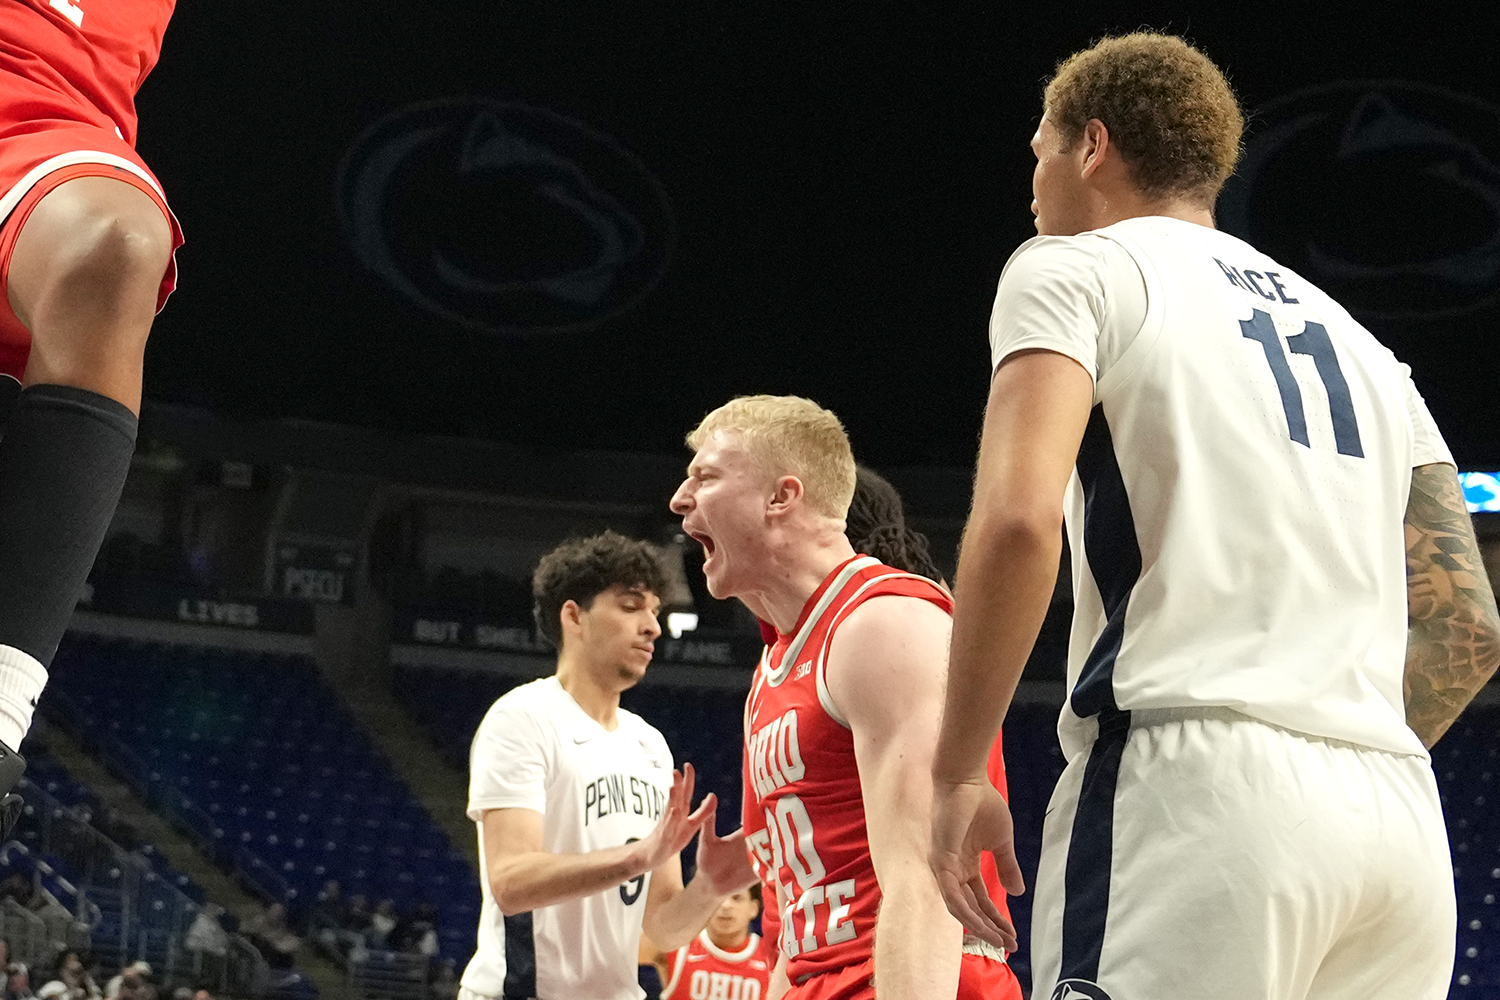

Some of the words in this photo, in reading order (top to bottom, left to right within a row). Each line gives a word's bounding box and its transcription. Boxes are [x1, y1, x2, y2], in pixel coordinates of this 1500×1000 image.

[1212, 256, 1299, 304] RICE
[1238, 307, 1365, 458] 11
[177, 599, 259, 626] LIVES
[414, 619, 461, 642] BUT
[585, 774, 626, 827] PENN
[630, 776, 665, 821] STAT
[779, 879, 857, 959] ATE
[690, 969, 761, 1000] OHIO
